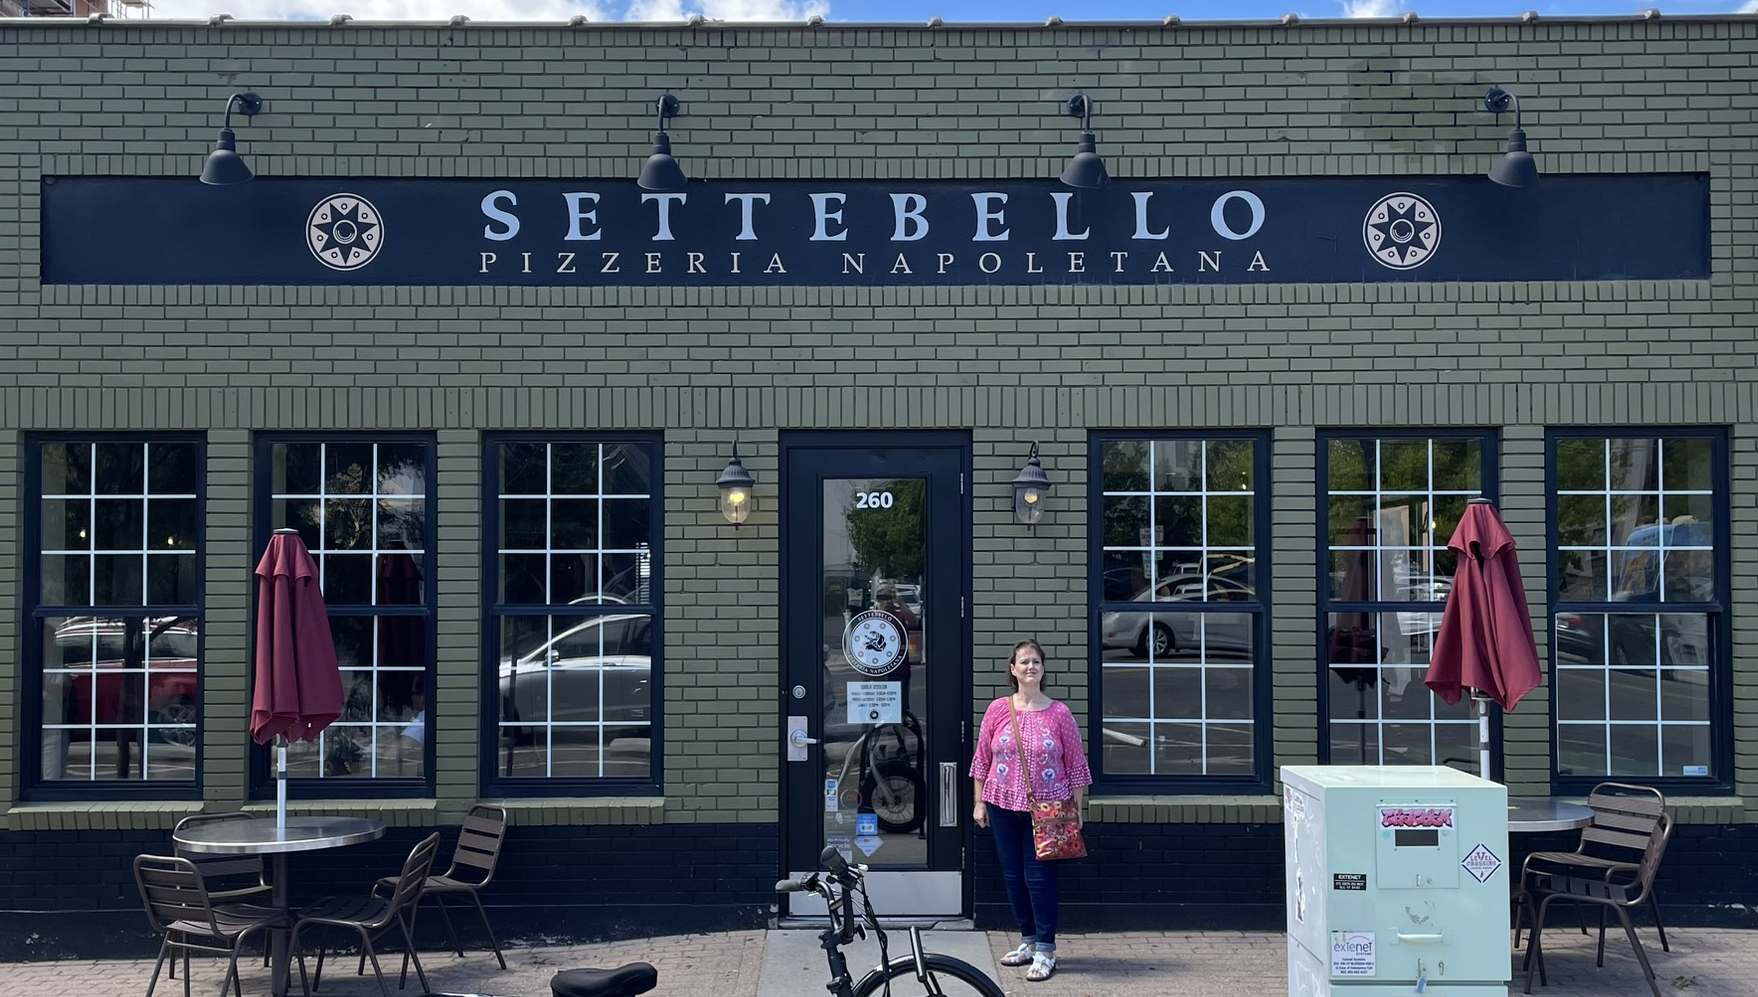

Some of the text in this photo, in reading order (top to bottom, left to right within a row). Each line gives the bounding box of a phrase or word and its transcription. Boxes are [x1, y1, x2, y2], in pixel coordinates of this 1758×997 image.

[480, 190, 1266, 241] SETTEBELLO
[480, 251, 1270, 274] PIZZERIA NAPOLETANA
[856, 492, 893, 509] 260
[857, 612, 893, 622] SETTEBELLO
[868, 655, 903, 674] NAPOLETANA
[1334, 941, 1373, 953] extenet
